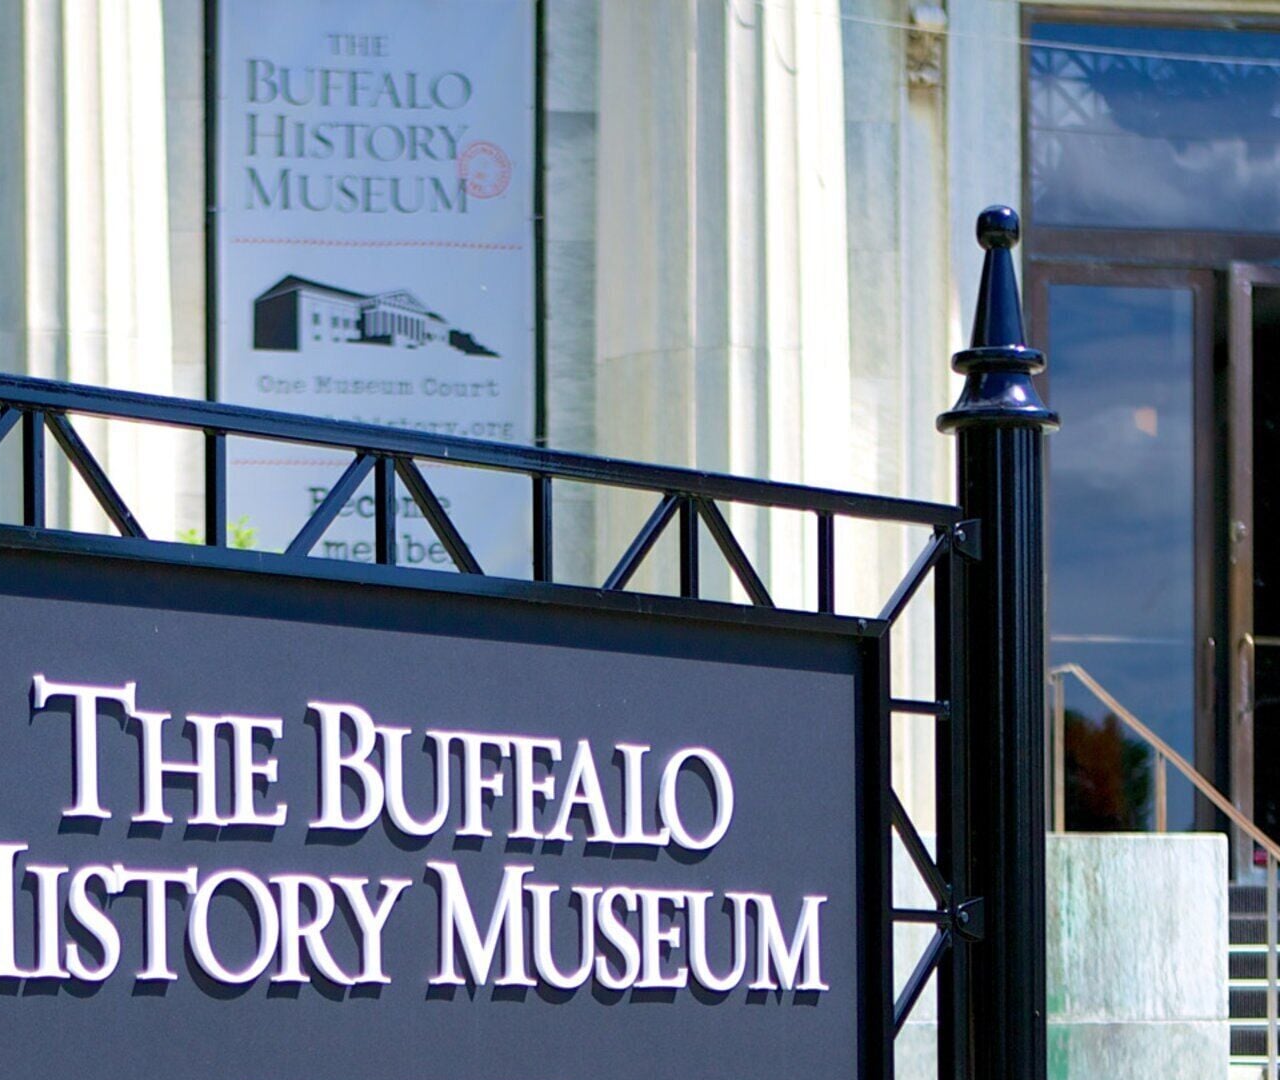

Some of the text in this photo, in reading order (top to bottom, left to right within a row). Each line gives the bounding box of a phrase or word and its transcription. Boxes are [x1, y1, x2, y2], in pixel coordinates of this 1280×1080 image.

[326, 34, 389, 57] THE
[245, 57, 473, 110] BUFFALO
[245, 112, 469, 162] HISTORY
[245, 166, 470, 213] MUSEUM
[258, 374, 501, 398] One Museum Court
[32, 673, 735, 851] THE BUFFALO
[425, 860, 830, 992] MUSEUM
